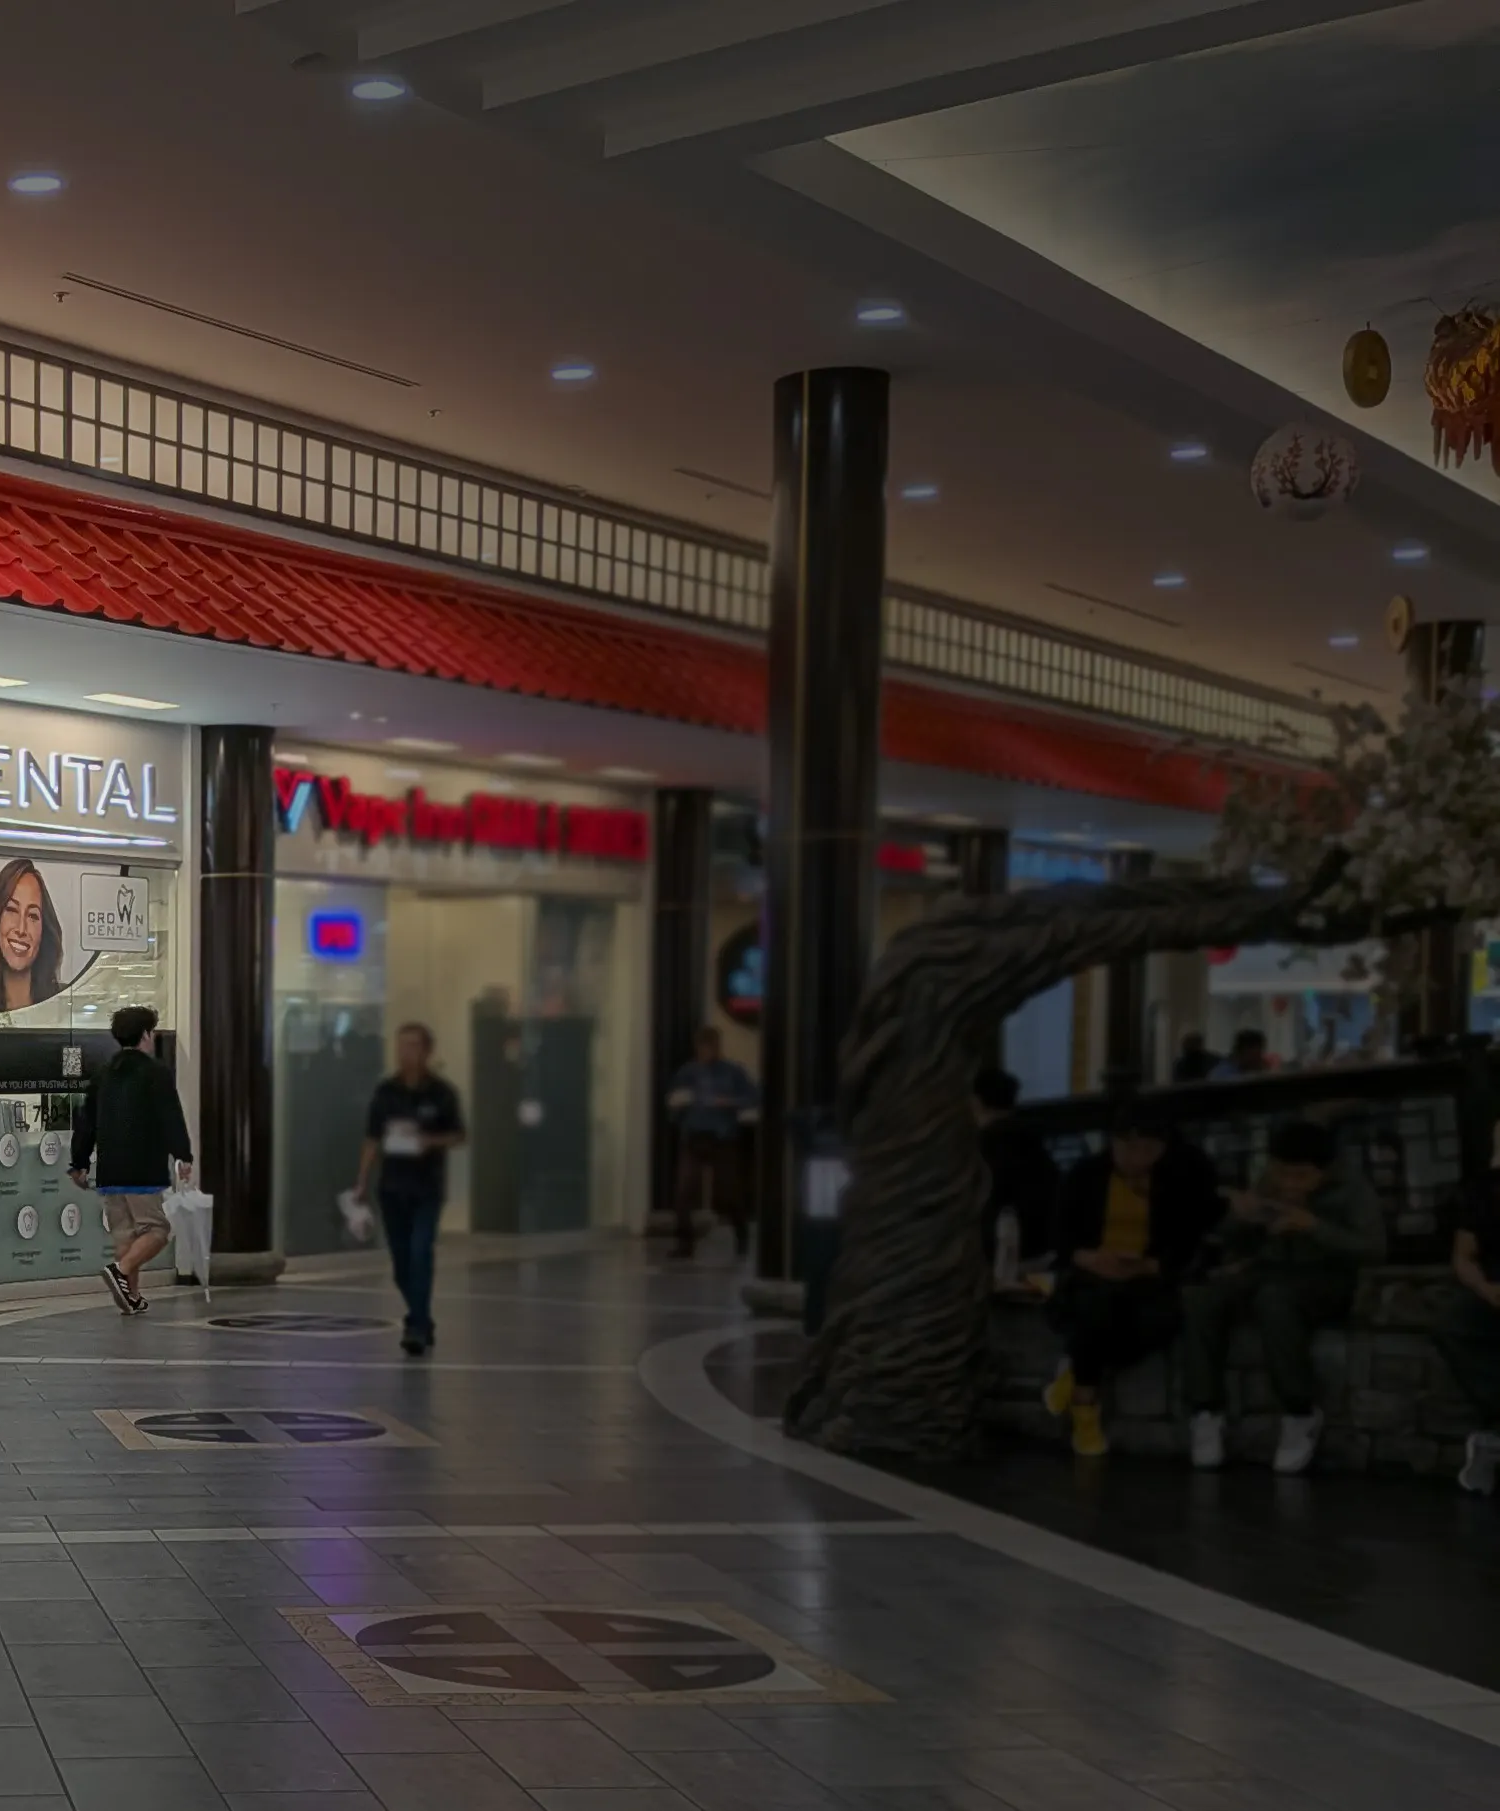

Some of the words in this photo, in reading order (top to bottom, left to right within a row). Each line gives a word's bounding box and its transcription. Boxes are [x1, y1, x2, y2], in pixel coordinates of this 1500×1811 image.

[87, 884, 143, 925] CROWN
[87, 925, 142, 938] DENTAL
[8, 1080, 23, 1089] YOU
[24, 1080, 37, 1089] FOR
[37, 1080, 68, 1089] TRUSTING
[69, 1080, 78, 1089] US
